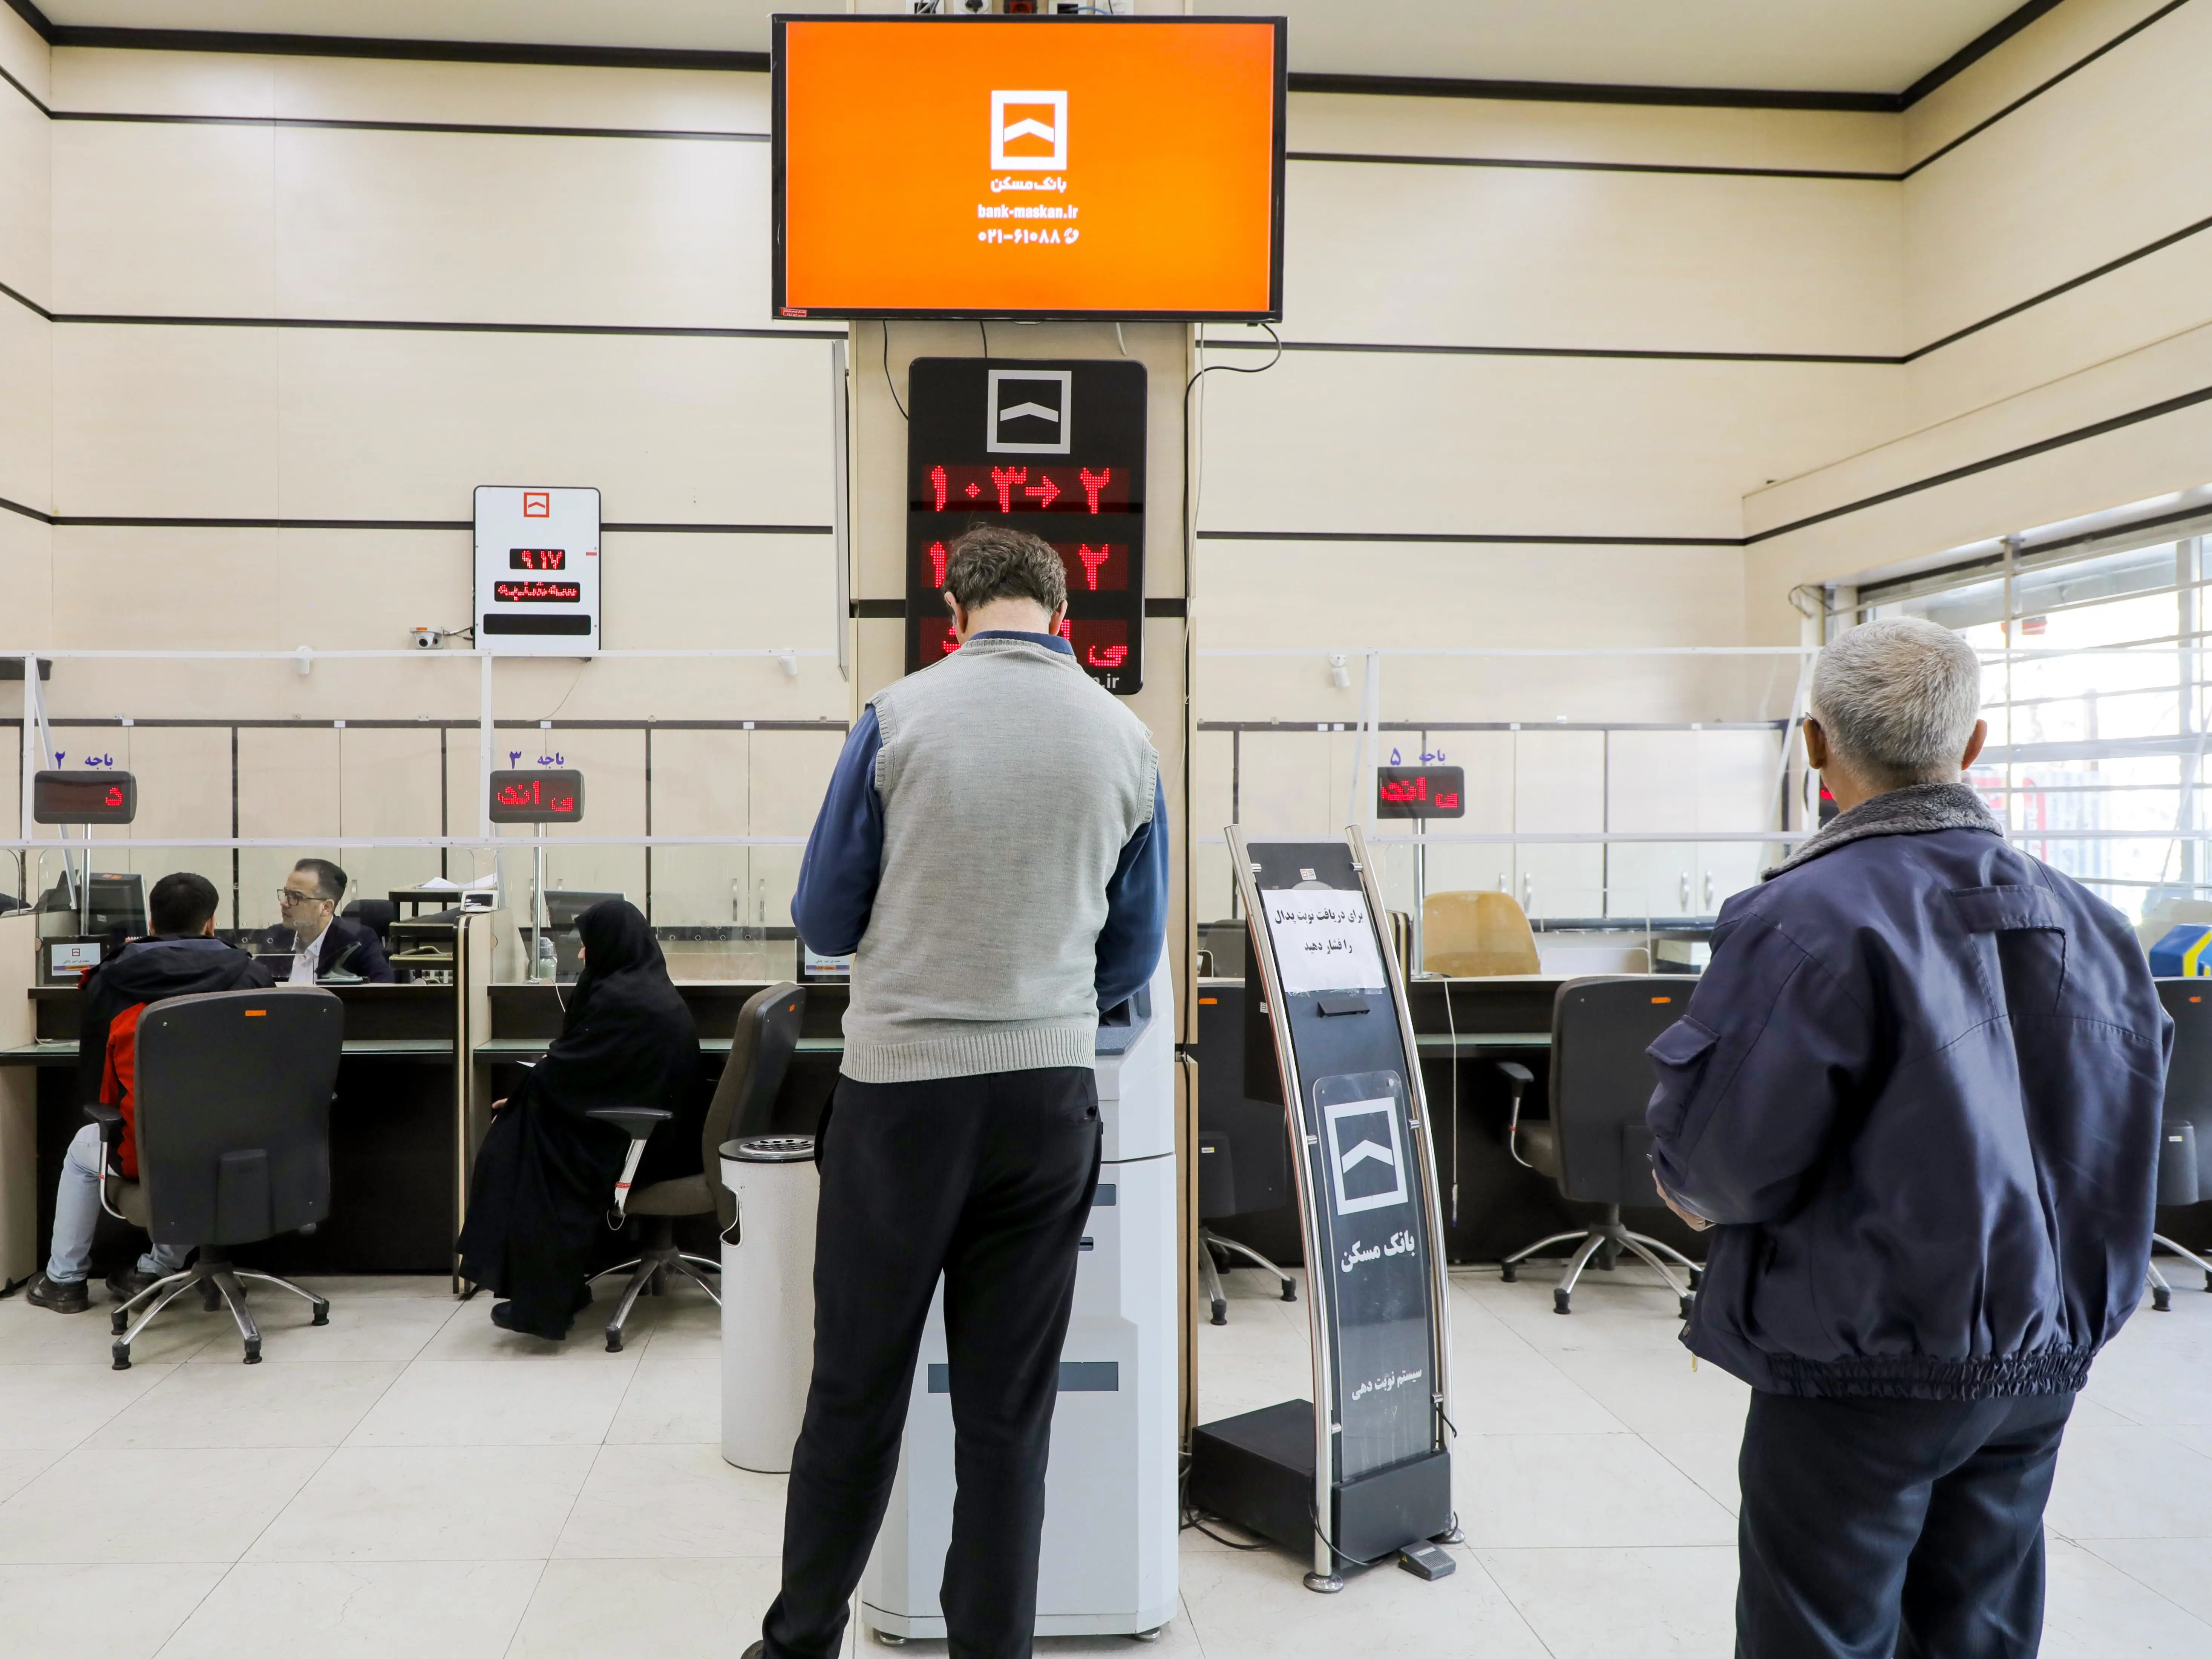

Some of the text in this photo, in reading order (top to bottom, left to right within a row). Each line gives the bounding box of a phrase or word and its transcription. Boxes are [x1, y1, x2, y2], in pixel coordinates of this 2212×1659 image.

[990, 176, 1067, 193] بانک مسکن
[978, 204, 1078, 219] bank-maskan.ir
[55, 751, 113, 770] باجه ۲
[509, 751, 564, 769] باجه ۳
[1390, 748, 1446, 766] باجه ۵
[1275, 908, 1364, 924] برای دریافت نوبت پدال
[1304, 938, 1353, 954] را فشار دهید
[1341, 1230, 1415, 1272] بانک مسکن
[1352, 1369, 1422, 1400] سیستم نوبت دهی
